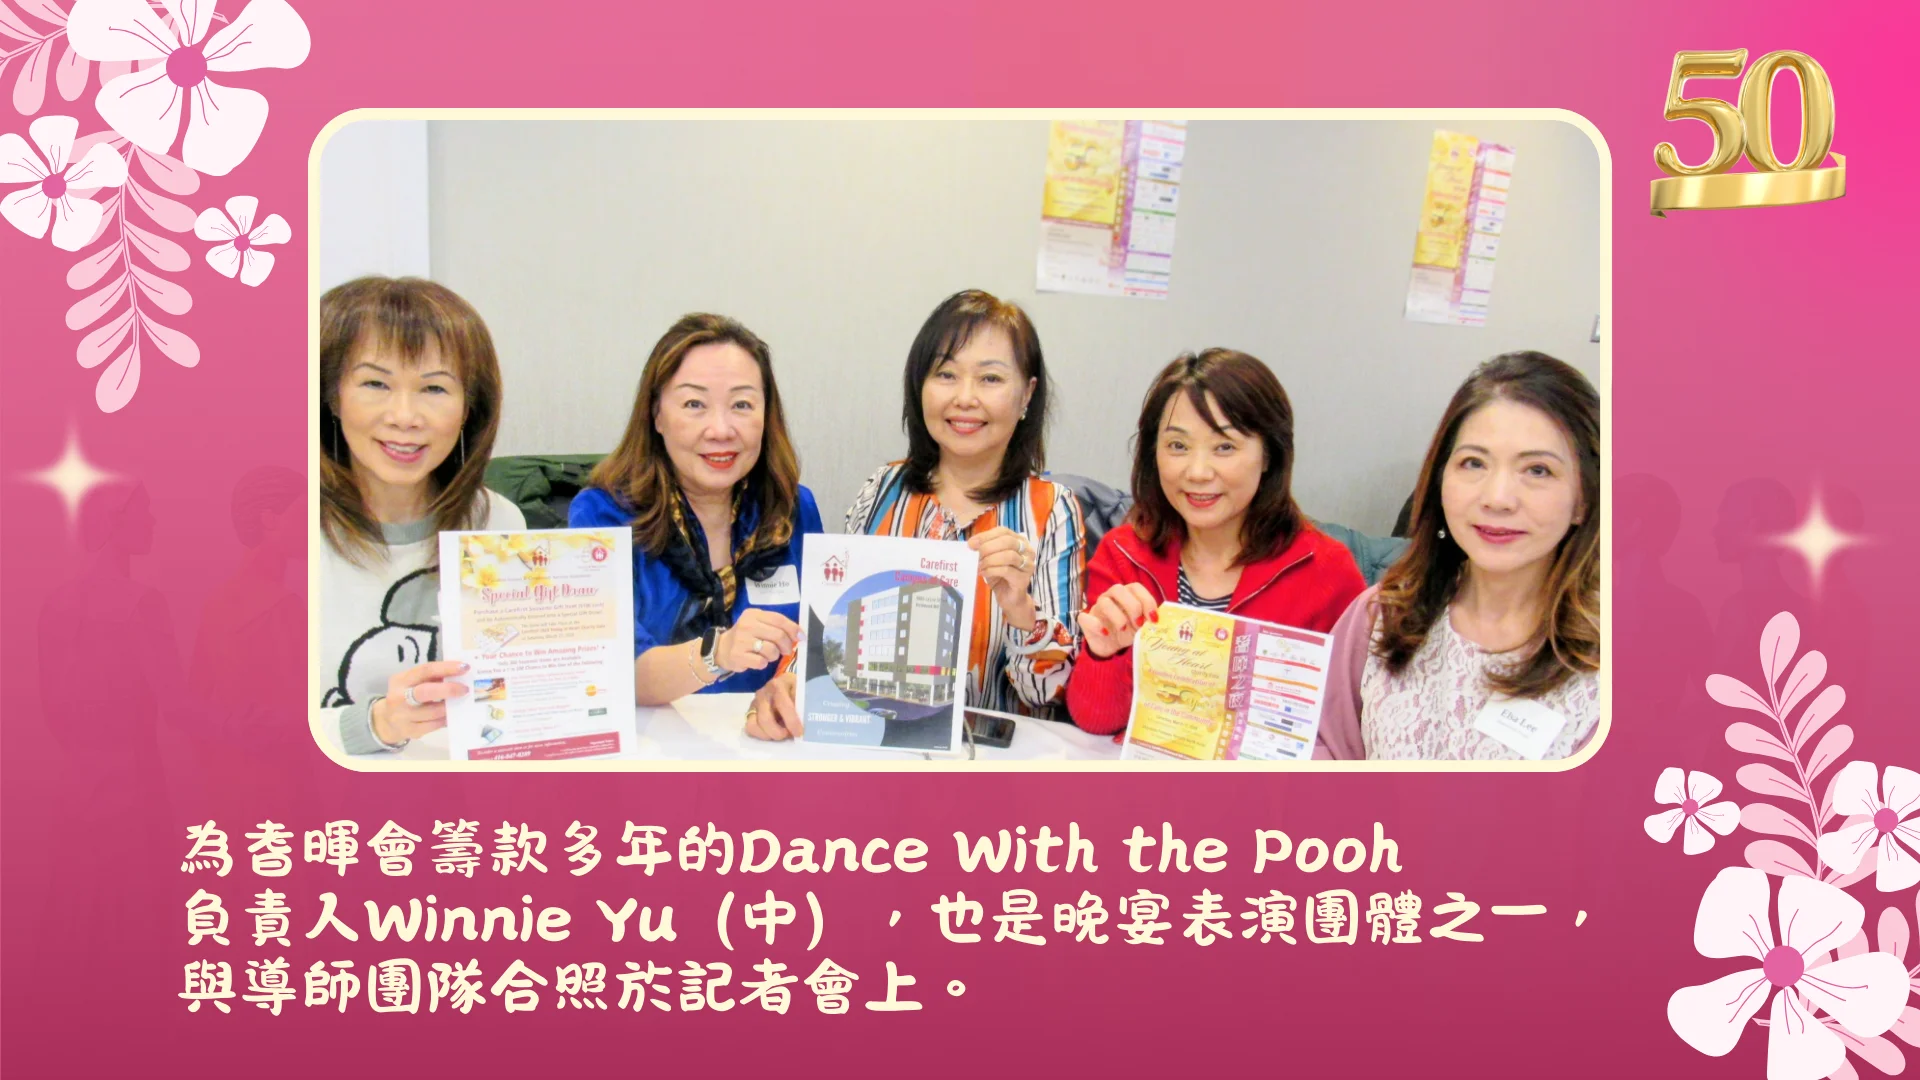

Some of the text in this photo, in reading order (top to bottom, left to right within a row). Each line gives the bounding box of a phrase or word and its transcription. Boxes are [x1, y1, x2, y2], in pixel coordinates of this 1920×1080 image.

[920, 557, 958, 572] Carefirst
[482, 583, 599, 607] Special Gift Draw
[807, 712, 838, 723] STRONGER
[845, 714, 872, 725] VIBRANT
[1519, 718, 1538, 733] Lee
